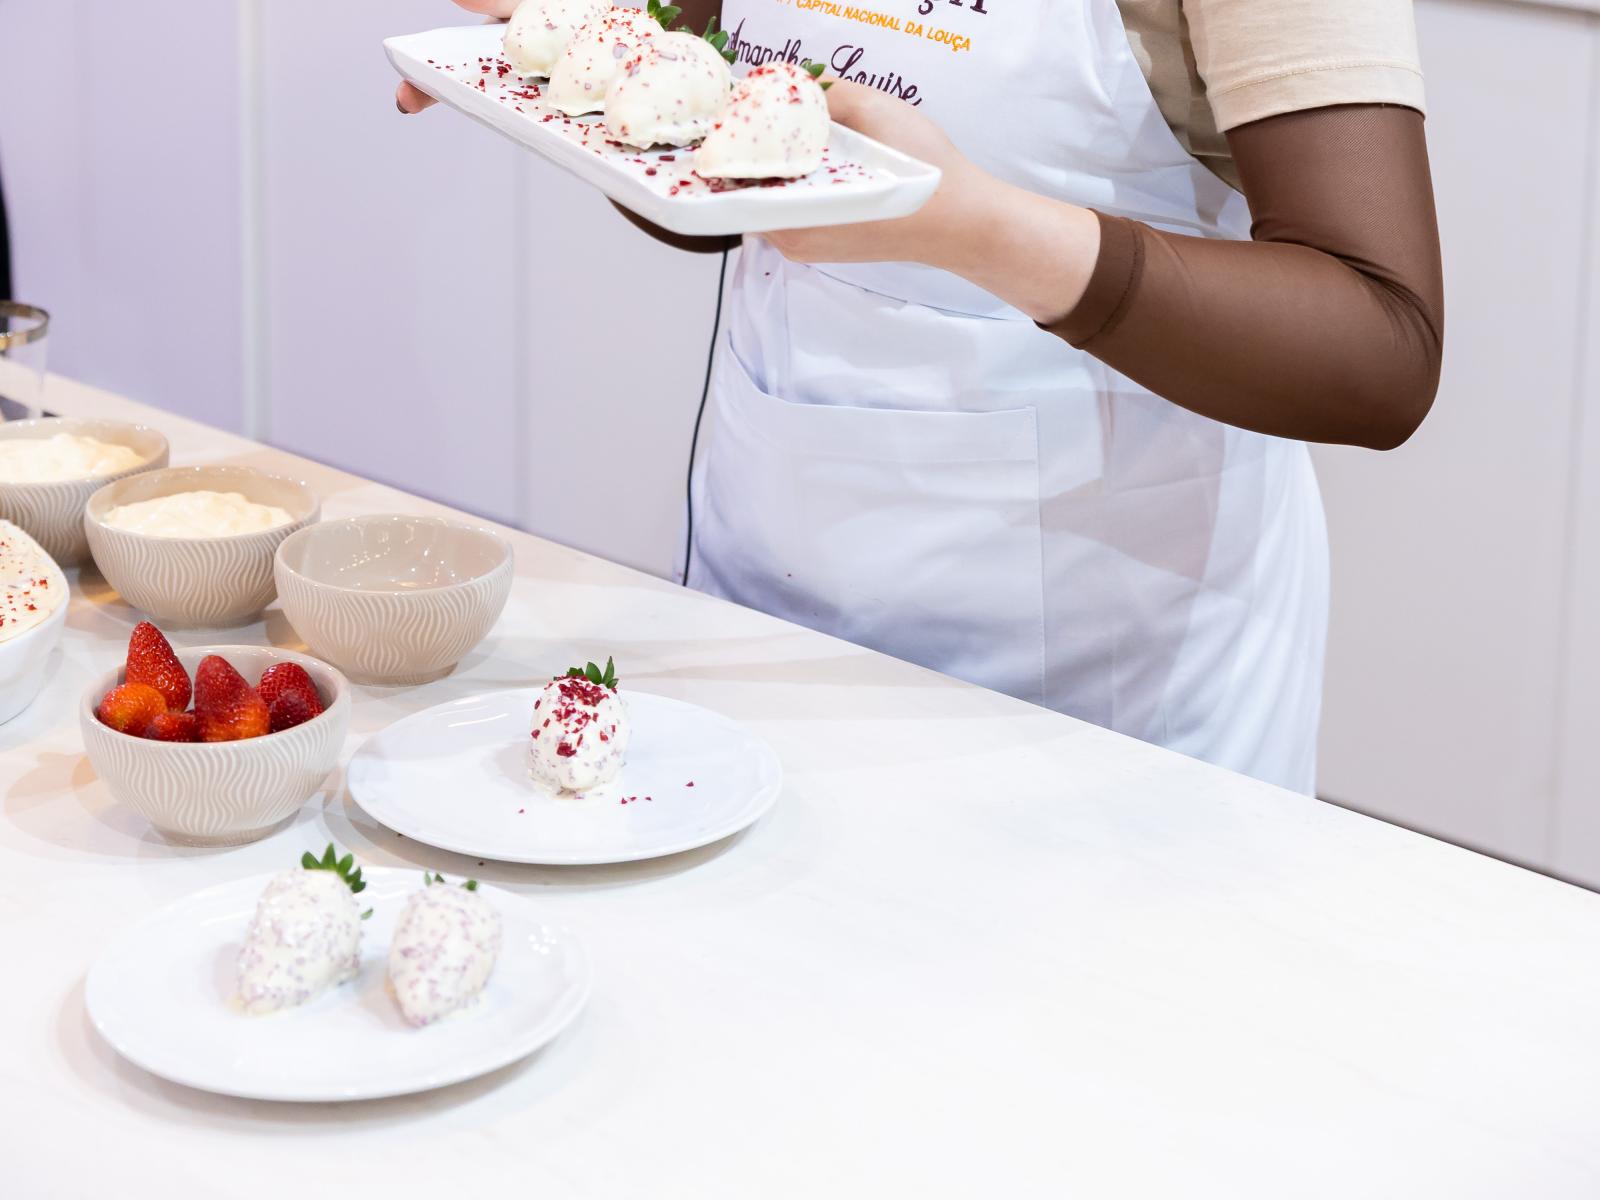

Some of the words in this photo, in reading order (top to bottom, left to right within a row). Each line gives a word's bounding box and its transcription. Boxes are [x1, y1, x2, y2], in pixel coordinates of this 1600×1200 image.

[843, 6, 901, 31] NACIONAL
[904, 21, 923, 38] DA
[927, 27, 972, 52] LOUÇA
